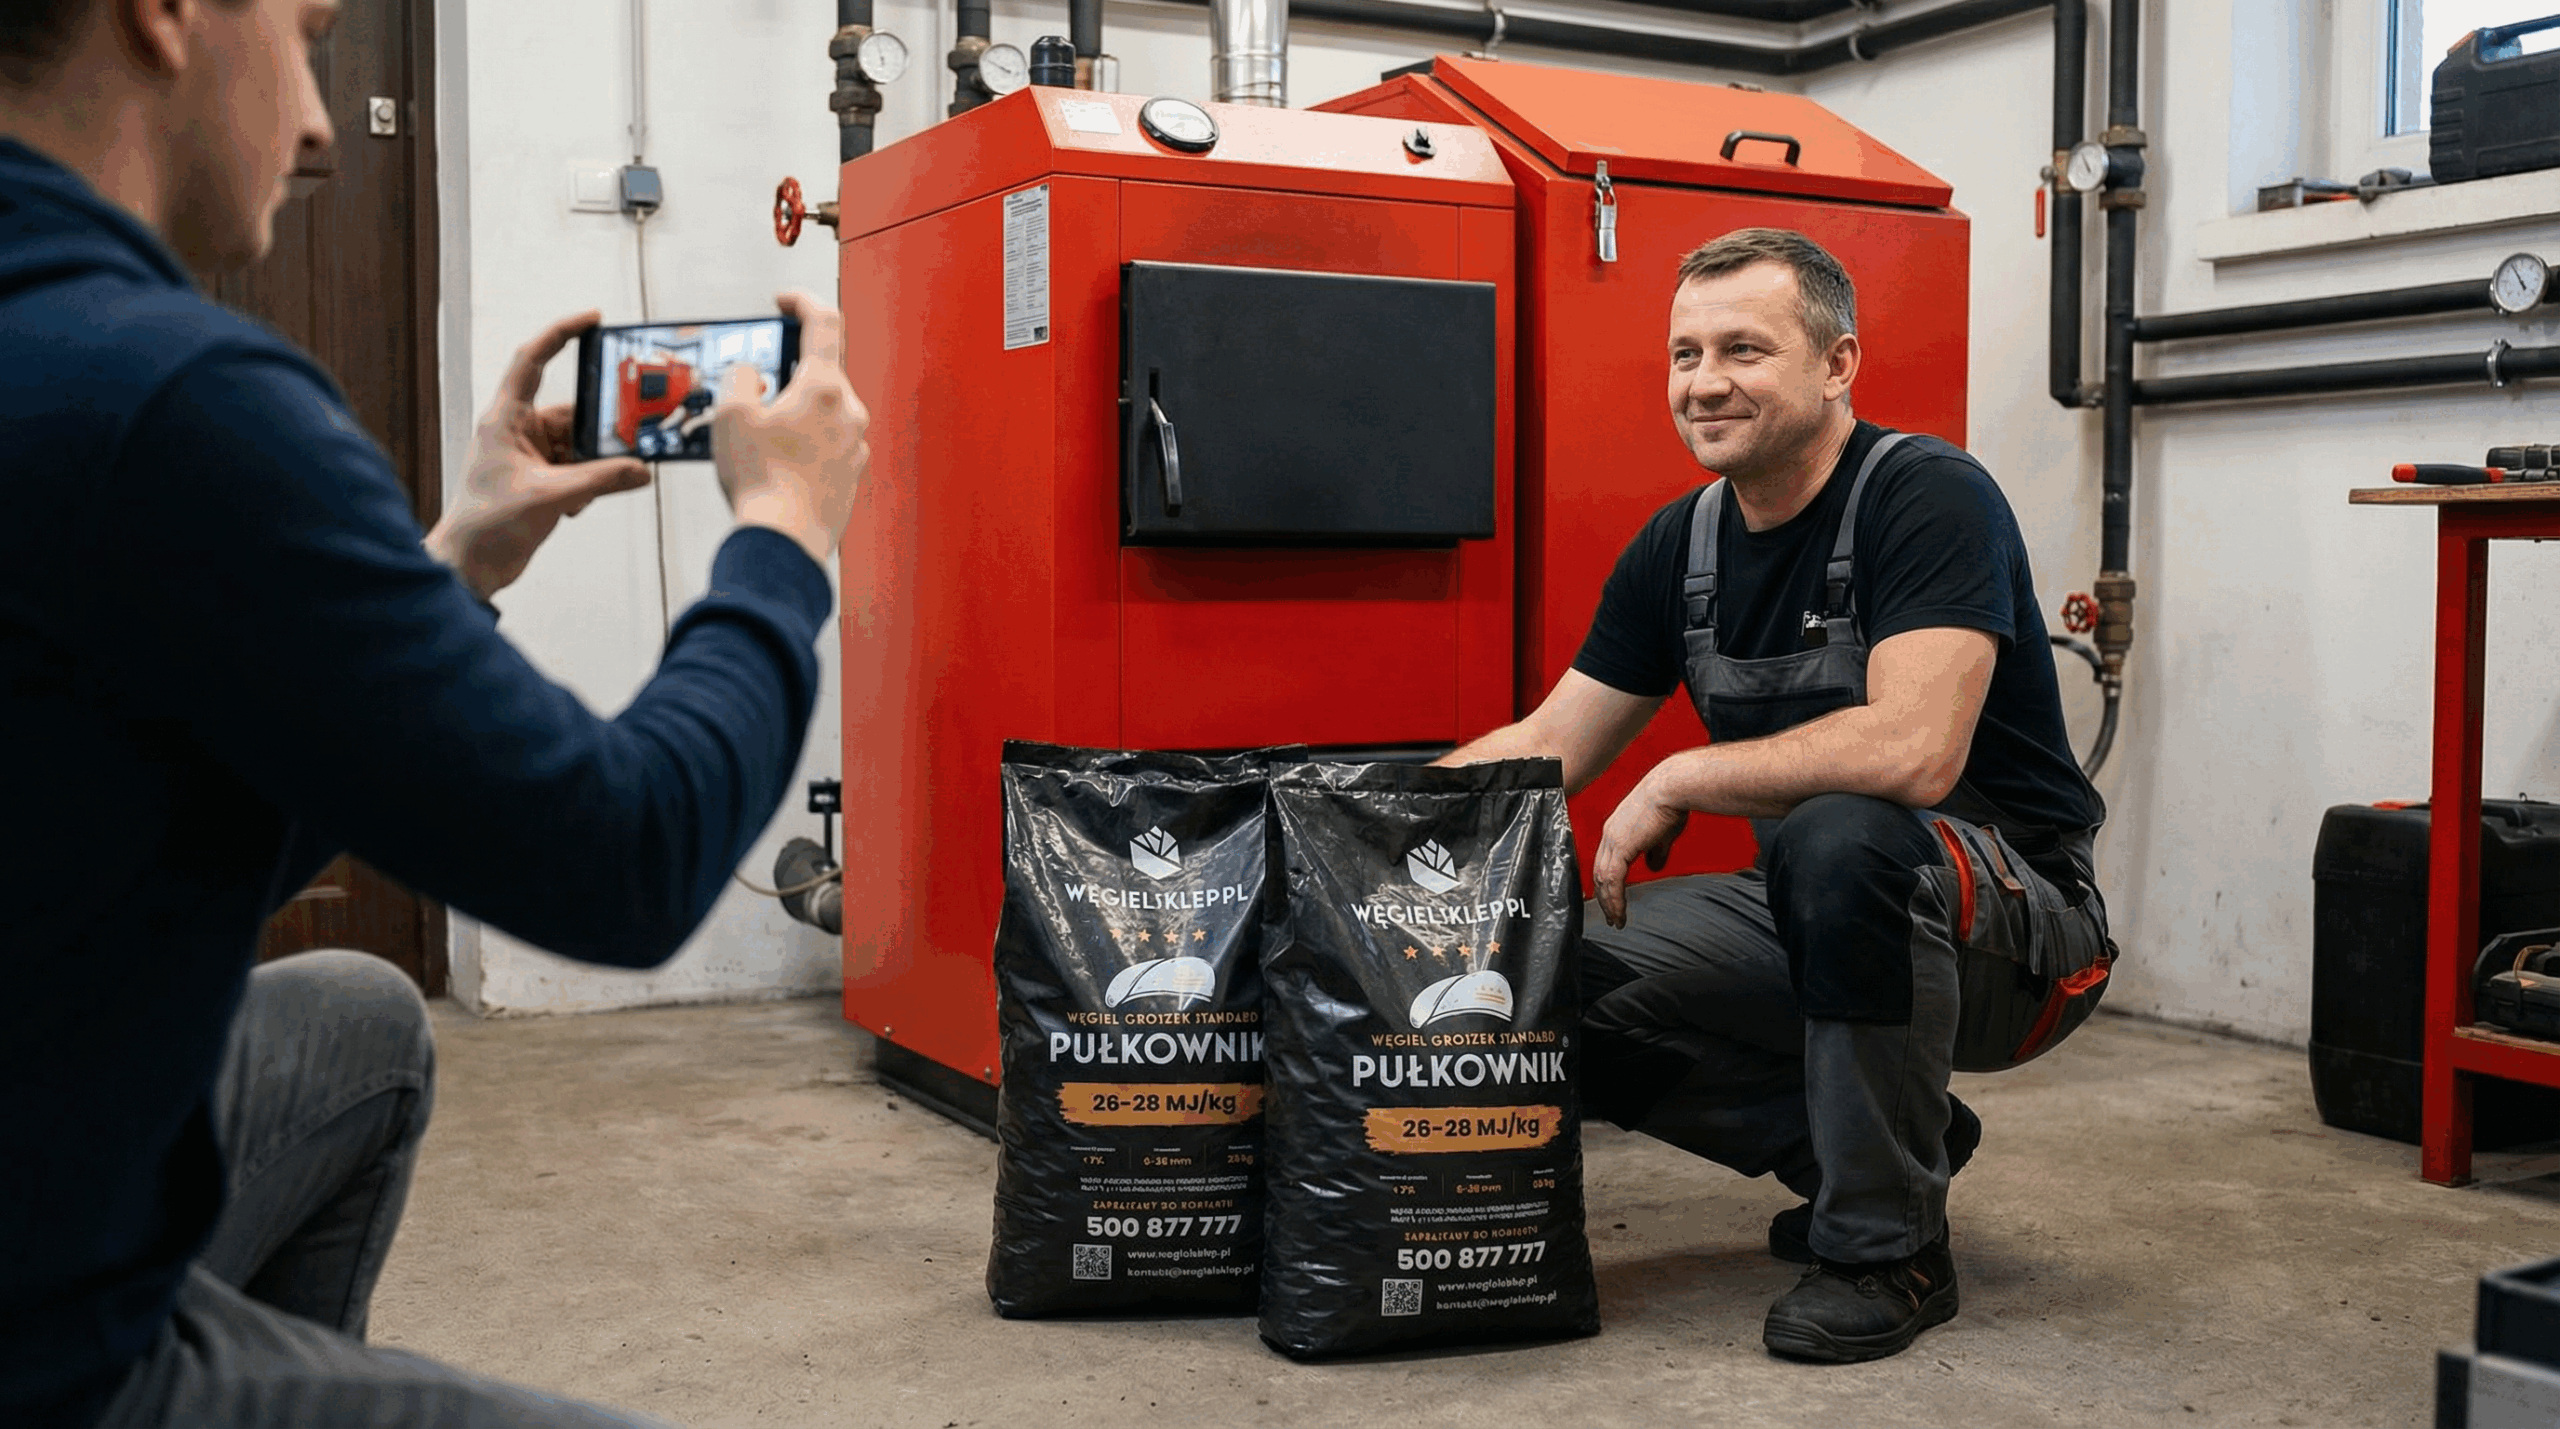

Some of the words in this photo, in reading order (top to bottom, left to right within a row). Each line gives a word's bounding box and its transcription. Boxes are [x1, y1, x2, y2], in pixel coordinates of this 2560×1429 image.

[1352, 1051, 1567, 1088] PUŁKOWNIK
[1166, 1089, 1236, 1115] MJ/kg
[1477, 1111, 1540, 1138] MJ/kg
[1087, 1216, 1140, 1238] 500
[1146, 1217, 1193, 1237] 877
[1199, 1215, 1242, 1236] 777
[1397, 1248, 1451, 1271] 500
[1458, 1246, 1504, 1269] 877
[1508, 1240, 1546, 1265] 777
